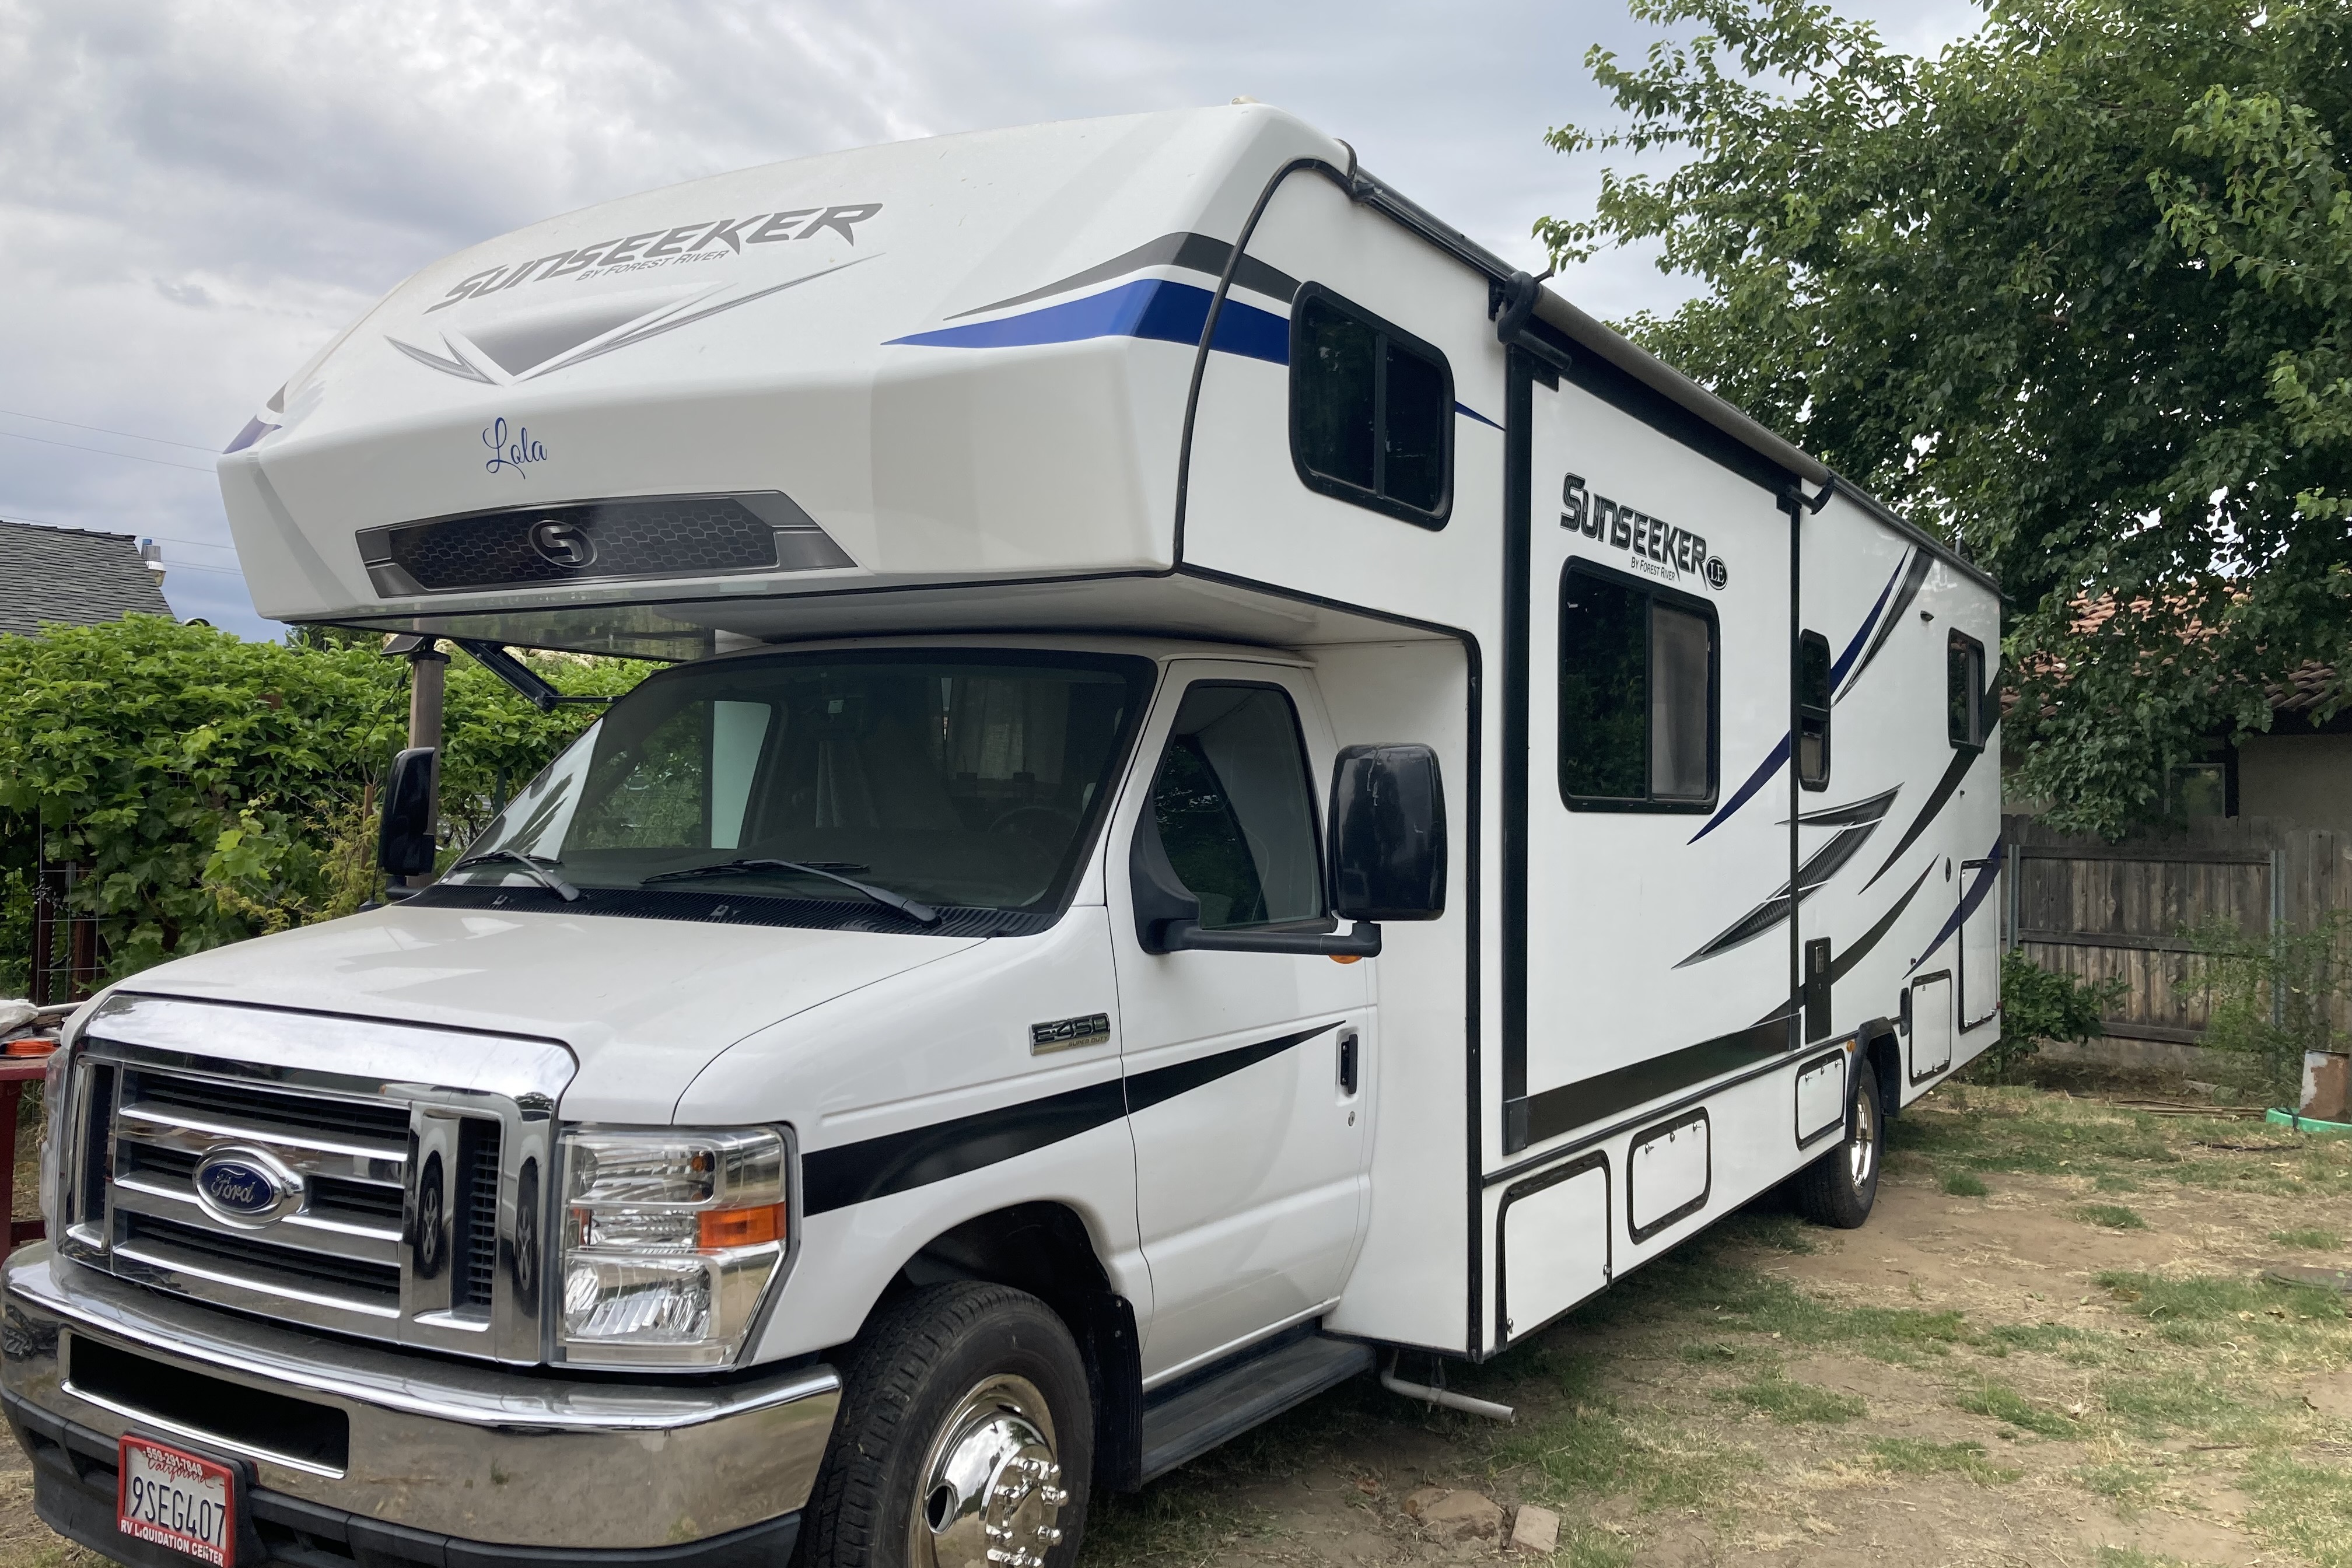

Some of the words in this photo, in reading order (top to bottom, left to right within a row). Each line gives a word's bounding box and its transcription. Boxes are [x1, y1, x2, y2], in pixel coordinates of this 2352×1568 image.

[422, 202, 883, 315] SUNSEEKER
[575, 269, 604, 282] BY
[602, 257, 674, 276] FOREST
[673, 250, 730, 265] RIVER
[482, 416, 547, 480] Lola
[540, 524, 584, 564] S
[1560, 472, 1708, 591] SUNSEEKER
[1709, 562, 1726, 583] LE
[1631, 556, 1639, 569] BY
[1640, 560, 1660, 576] FOREST
[1660, 567, 1675, 582] RIVER
[1034, 1015, 1109, 1044] E-450
[1068, 1038, 1090, 1047] SUPER
[211, 1168, 257, 1204] Ford
[146, 1446, 203, 1476] 559-291-7848
[131, 1476, 227, 1548] 9SEG407
[120, 1519, 133, 1534] RV
[134, 1523, 190, 1553] LIQUIDATION
[191, 1542, 223, 1567] CENTER
